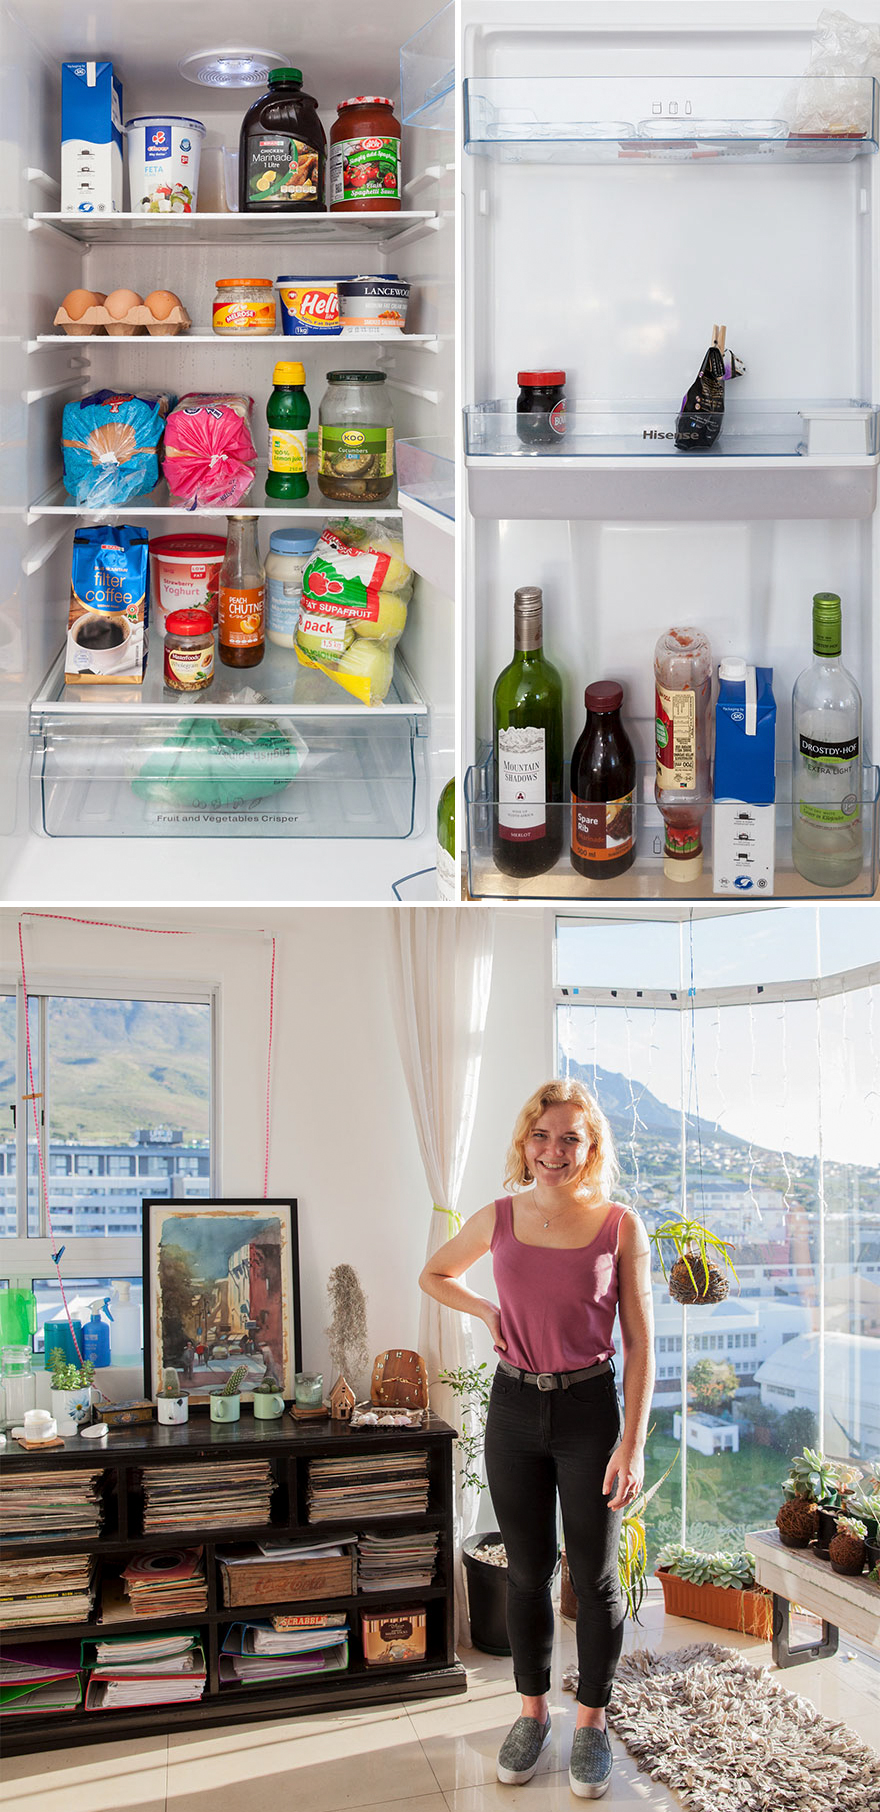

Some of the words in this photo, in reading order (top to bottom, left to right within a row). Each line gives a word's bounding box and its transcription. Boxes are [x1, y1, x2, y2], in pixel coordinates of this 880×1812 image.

[252, 153, 292, 162] Marinade
[350, 188, 380, 197] Spaghetti
[226, 310, 255, 323] MELROSE
[344, 434, 364, 442] KOO
[642, 430, 700, 440] Hisense
[338, 446, 369, 454] Cucumbers
[94, 571, 127, 588] filter
[163, 578, 194, 588] Strawberry
[85, 588, 133, 604] coffee
[163, 584, 200, 597] Yoghurt
[228, 596, 248, 604] PEACH
[228, 600, 265, 615] CHUTNE
[319, 603, 373, 618] SUPAFRUIT
[303, 619, 334, 635] pack
[503, 760, 540, 772] MOUNTAIN
[807, 763, 831, 775] EXTRA
[832, 765, 853, 775] LIGHT
[504, 773, 538, 783] SHADOWS
[181, 815, 201, 823] and
[202, 815, 259, 824] Vegetables
[261, 815, 299, 824] Crisper
[577, 812, 599, 826] Spare
[577, 822, 590, 833] Rib
